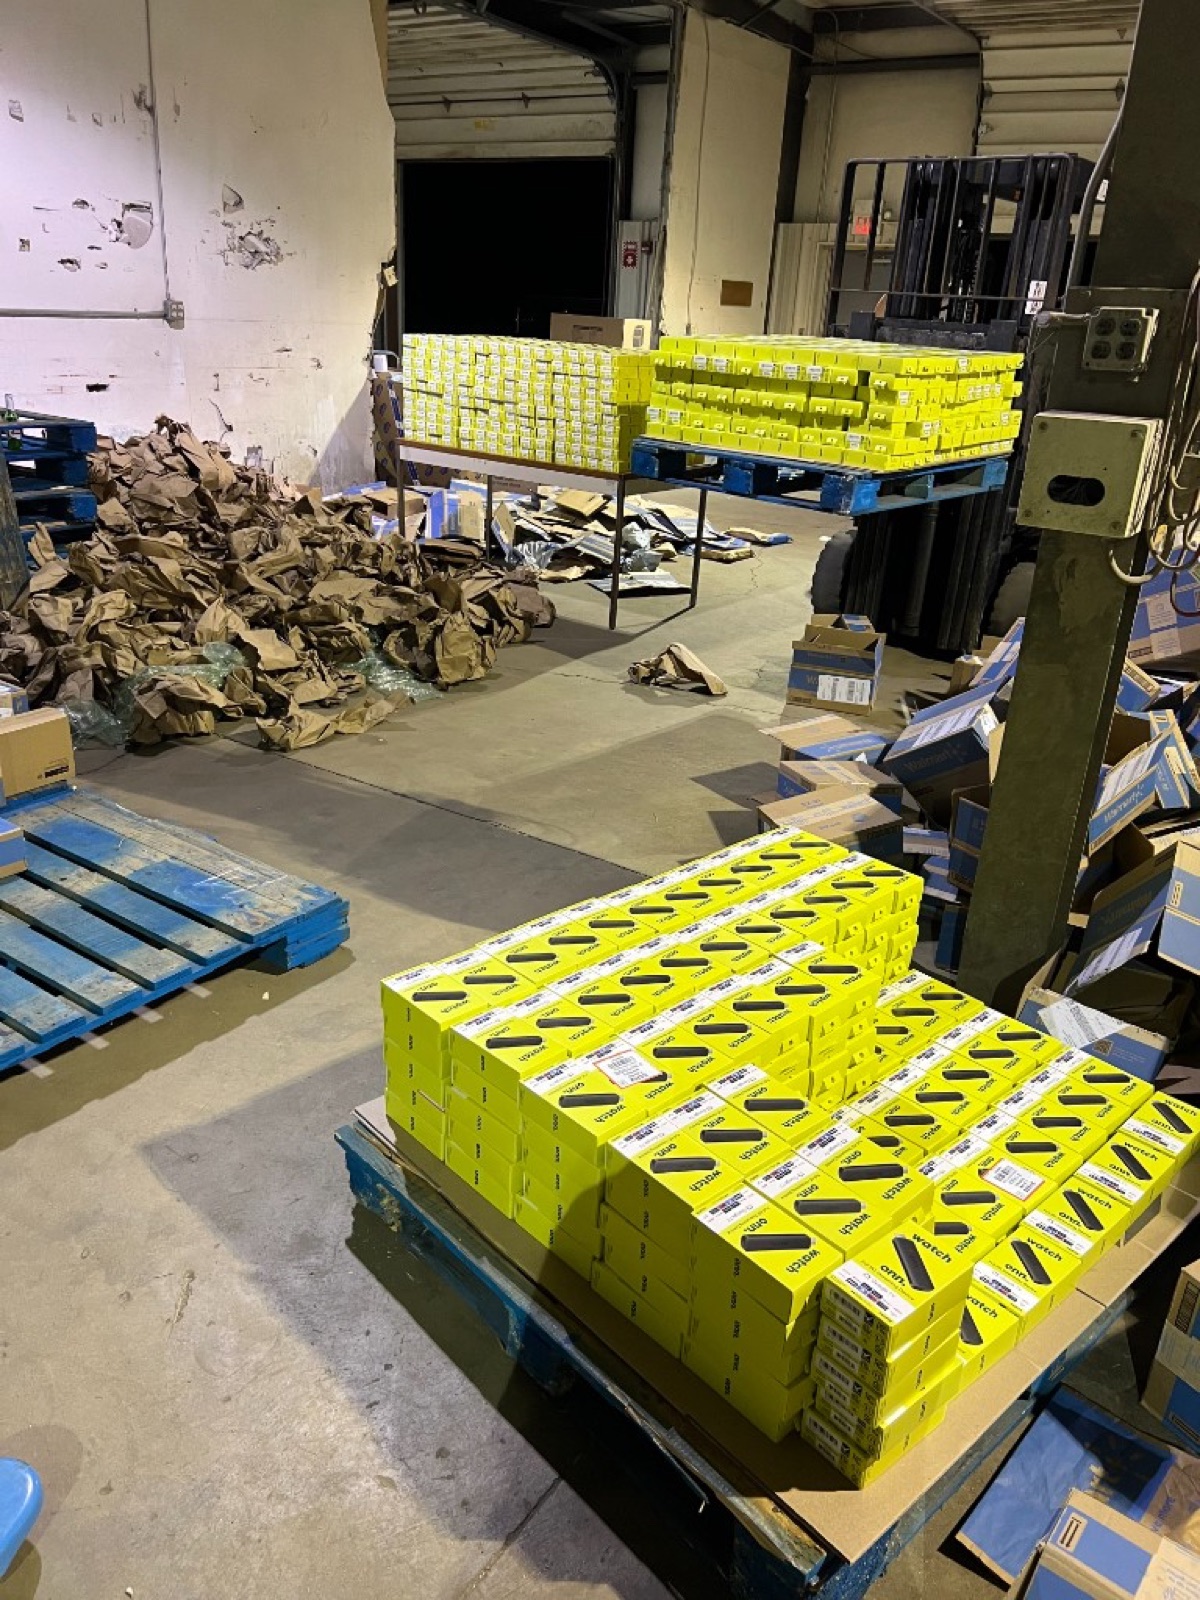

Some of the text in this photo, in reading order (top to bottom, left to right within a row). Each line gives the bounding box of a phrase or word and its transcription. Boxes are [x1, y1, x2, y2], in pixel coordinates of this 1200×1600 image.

[611, 1002, 635, 1017] watch
[568, 1026, 597, 1041] watch
[728, 1033, 754, 1048] watch
[518, 1045, 547, 1062] watch
[687, 1056, 715, 1072] watch
[564, 1082, 585, 1094] onn.
[644, 1082, 673, 1099] watch
[747, 1087, 768, 1097] onn.
[594, 1104, 626, 1123] watch
[1165, 1099, 1198, 1117] watch
[702, 1116, 725, 1128] onn.
[781, 1110, 811, 1127] watch
[655, 1143, 677, 1157] onn.
[738, 1141, 770, 1160] watch
[840, 1150, 862, 1164] onn.
[1124, 1141, 1159, 1161] watch
[689, 1170, 722, 1191] watch
[881, 1178, 913, 1200] watch
[797, 1184, 819, 1198] onn.
[1077, 1187, 1112, 1209] watch
[744, 1218, 768, 1232] onn.
[839, 1213, 871, 1235] watch
[1058, 1211, 1082, 1226] onn.
[912, 1234, 952, 1263] watch
[1027, 1237, 1063, 1262] watch
[786, 1250, 820, 1273] watch
[880, 1265, 906, 1286] onn.
[1004, 1263, 1029, 1282] onn.
